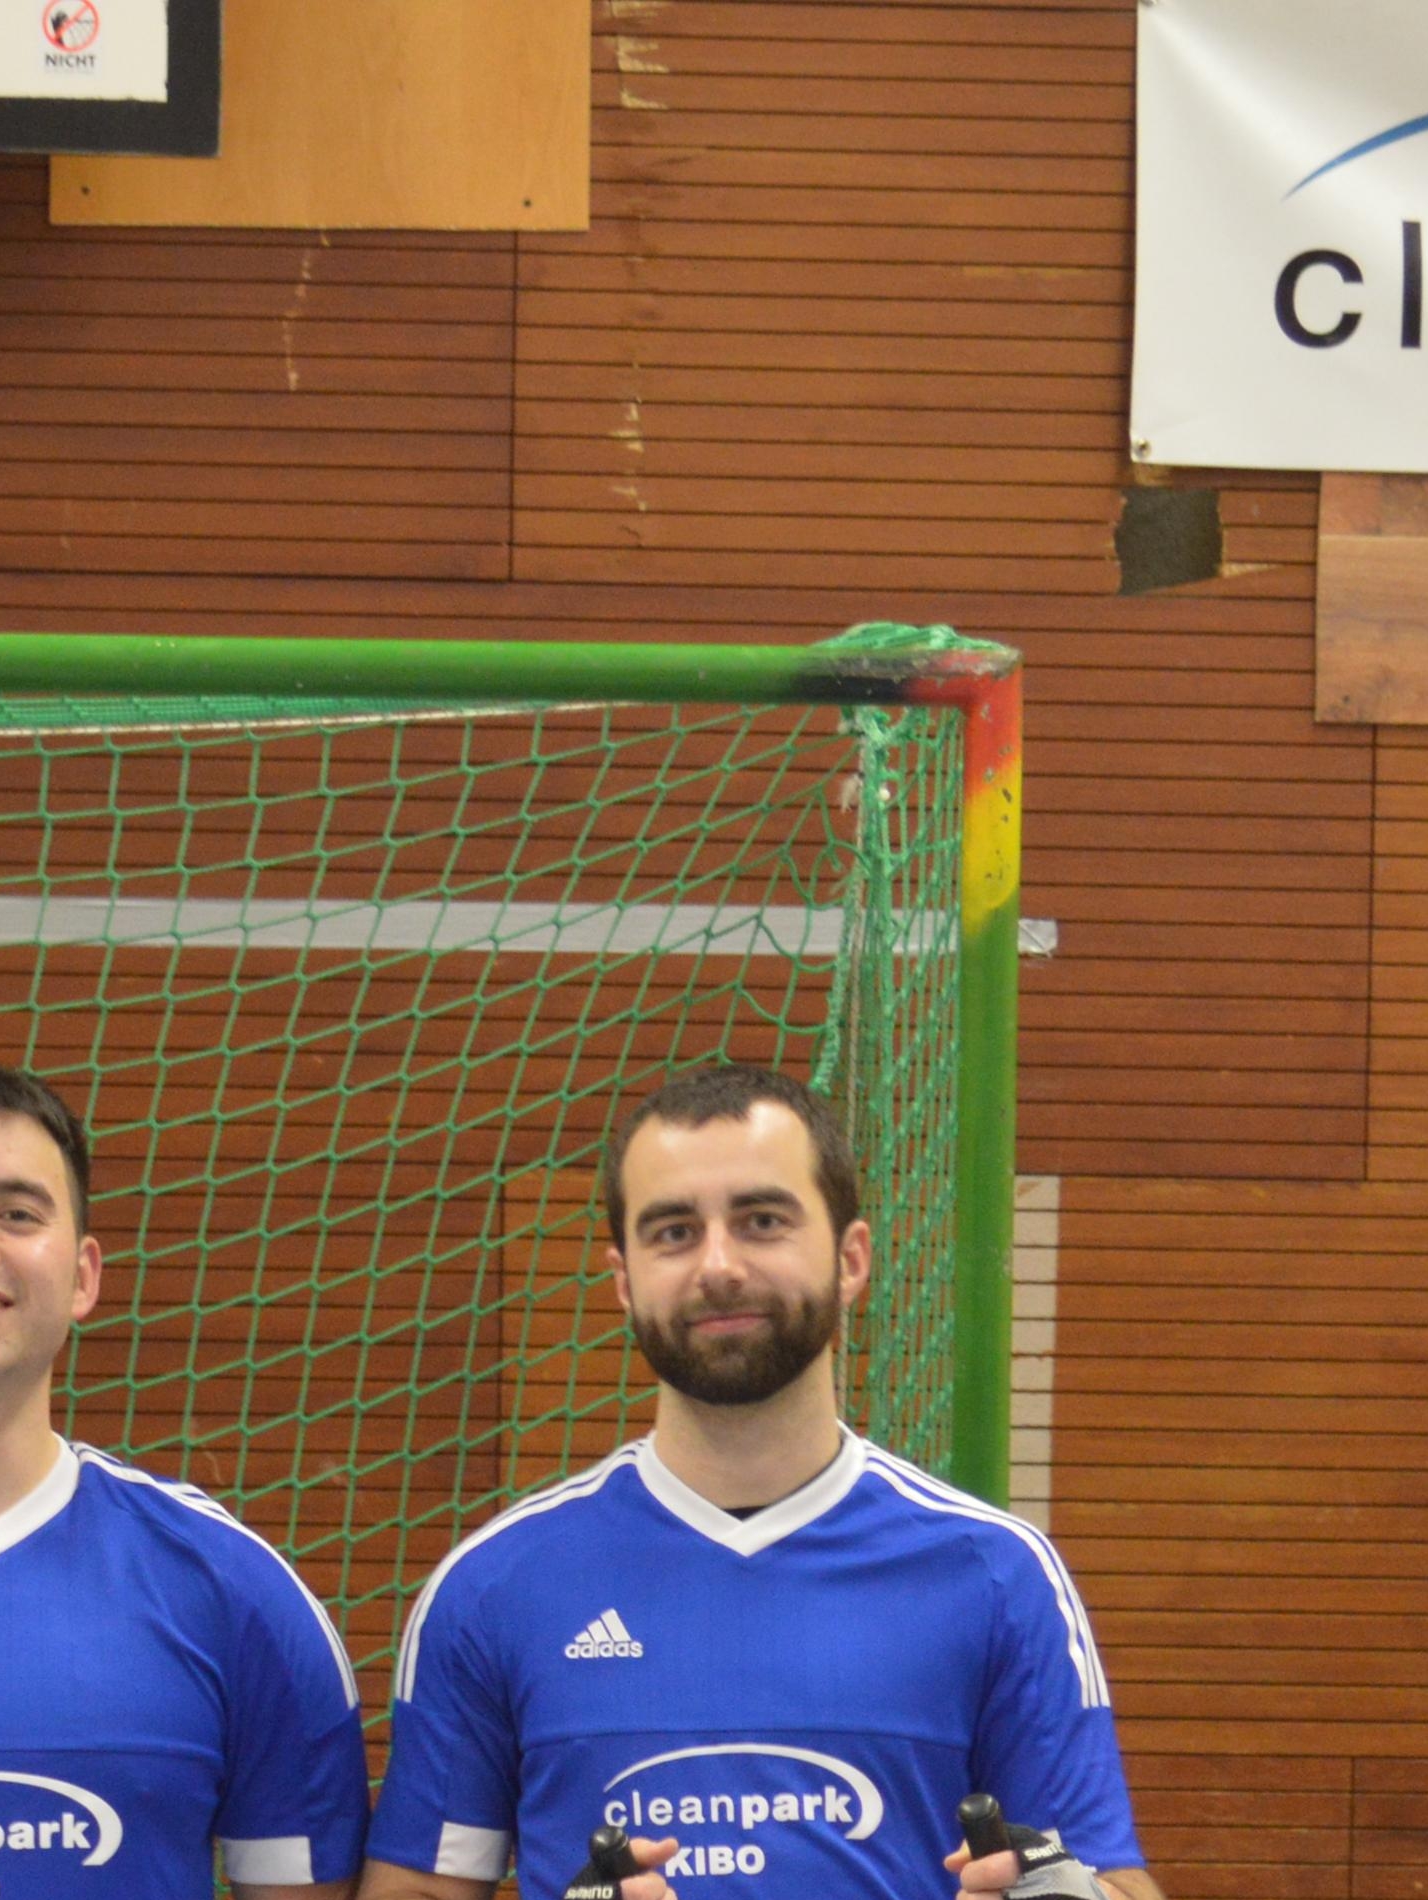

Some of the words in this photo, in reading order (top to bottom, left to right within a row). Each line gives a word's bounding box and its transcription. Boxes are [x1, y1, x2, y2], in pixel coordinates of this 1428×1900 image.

[45, 54, 97, 68] NICHT
[564, 1638, 644, 1659] adidas
[603, 1785, 854, 1830] cleanpark
[663, 1844, 767, 1878] KIBO
